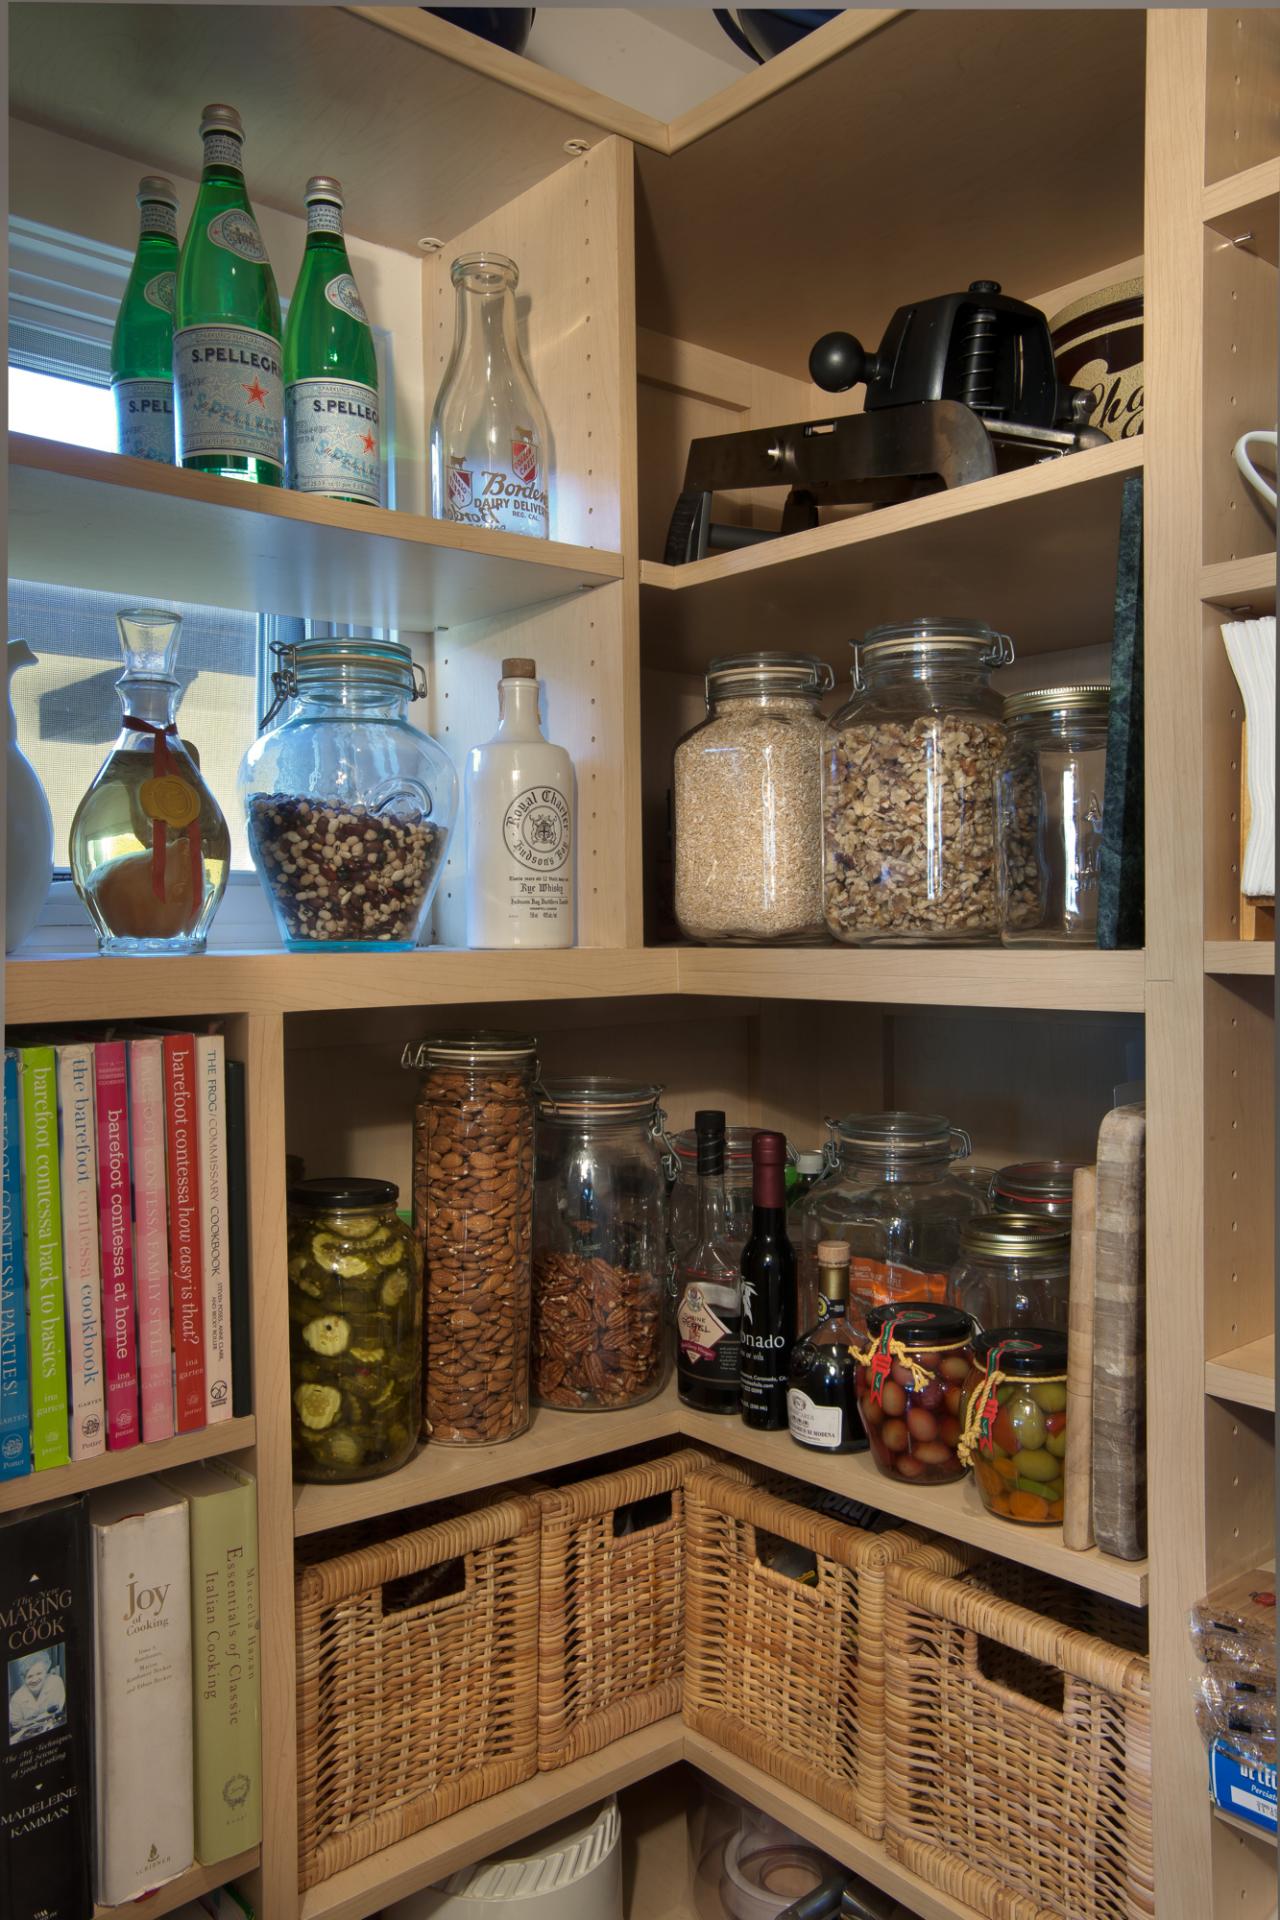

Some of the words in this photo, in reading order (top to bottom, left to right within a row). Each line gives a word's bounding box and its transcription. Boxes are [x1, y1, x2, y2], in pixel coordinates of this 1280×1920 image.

[192, 347, 280, 377] S.PELLEGR
[129, 399, 173, 414] S.PEL
[474, 498, 510, 510] DAIRY
[506, 791, 538, 829] Royal
[541, 789, 569, 831] Charter
[520, 882, 536, 894] Rye
[539, 882, 563, 895] Whisky
[73, 1059, 88, 1092] the
[207, 1050, 217, 1075] THE
[33, 1067, 53, 1149] barefoot
[172, 1051, 191, 1125] barefoot
[75, 1098, 91, 1185] barefoot
[107, 1109, 124, 1189] barefoot
[175, 1129, 191, 1204] contessa
[36, 1154, 52, 1240] contessa
[144, 1148, 158, 1236] CONTESSA
[78, 1190, 92, 1279] contessa
[110, 1194, 125, 1278] contessa
[178, 1206, 195, 1242] how
[210, 1206, 221, 1277] COOKBOOK
[40, 1241, 59, 1289] back
[147, 1240, 162, 1303] FAMILY
[174, 1246, 192, 1283] easy
[41, 1294, 56, 1315] to
[115, 1283, 128, 1302] at
[180, 1286, 196, 1300] is
[81, 1284, 99, 1386] cookbook
[115, 1305, 130, 1359] home
[150, 1307, 164, 1359] STYLE
[181, 1302, 200, 1345] that?
[741, 1334, 785, 1348] onado
[1, 1308, 17, 1397] PARTIES!
[41, 1316, 61, 1378] basics
[185, 1359, 198, 1367] ina
[179, 1368, 204, 1380] garten
[0, 1413, 28, 1425] ARTEN
[813, 1430, 836, 1438] MODENA
[82, 1439, 102, 1450] Potter
[0, 1589, 72, 1629] MAKING
[123, 1572, 171, 1620] joy
[206, 1569, 220, 1624] Italian
[226, 1545, 243, 1637] Essentials
[247, 1567, 257, 1630] Marcella
[8, 1615, 64, 1649] COOK
[126, 1618, 169, 1636] Cooking
[132, 1613, 142, 1624] of
[203, 1630, 221, 1700] Cooking
[225, 1643, 241, 1659] of
[247, 1635, 257, 1680] Hazan
[228, 1664, 242, 1725] Classic
[0, 1786, 78, 1825] MADELEINE
[1251, 1784, 1277, 1802] Perciat
[10, 1805, 70, 1838] KAMMAN
